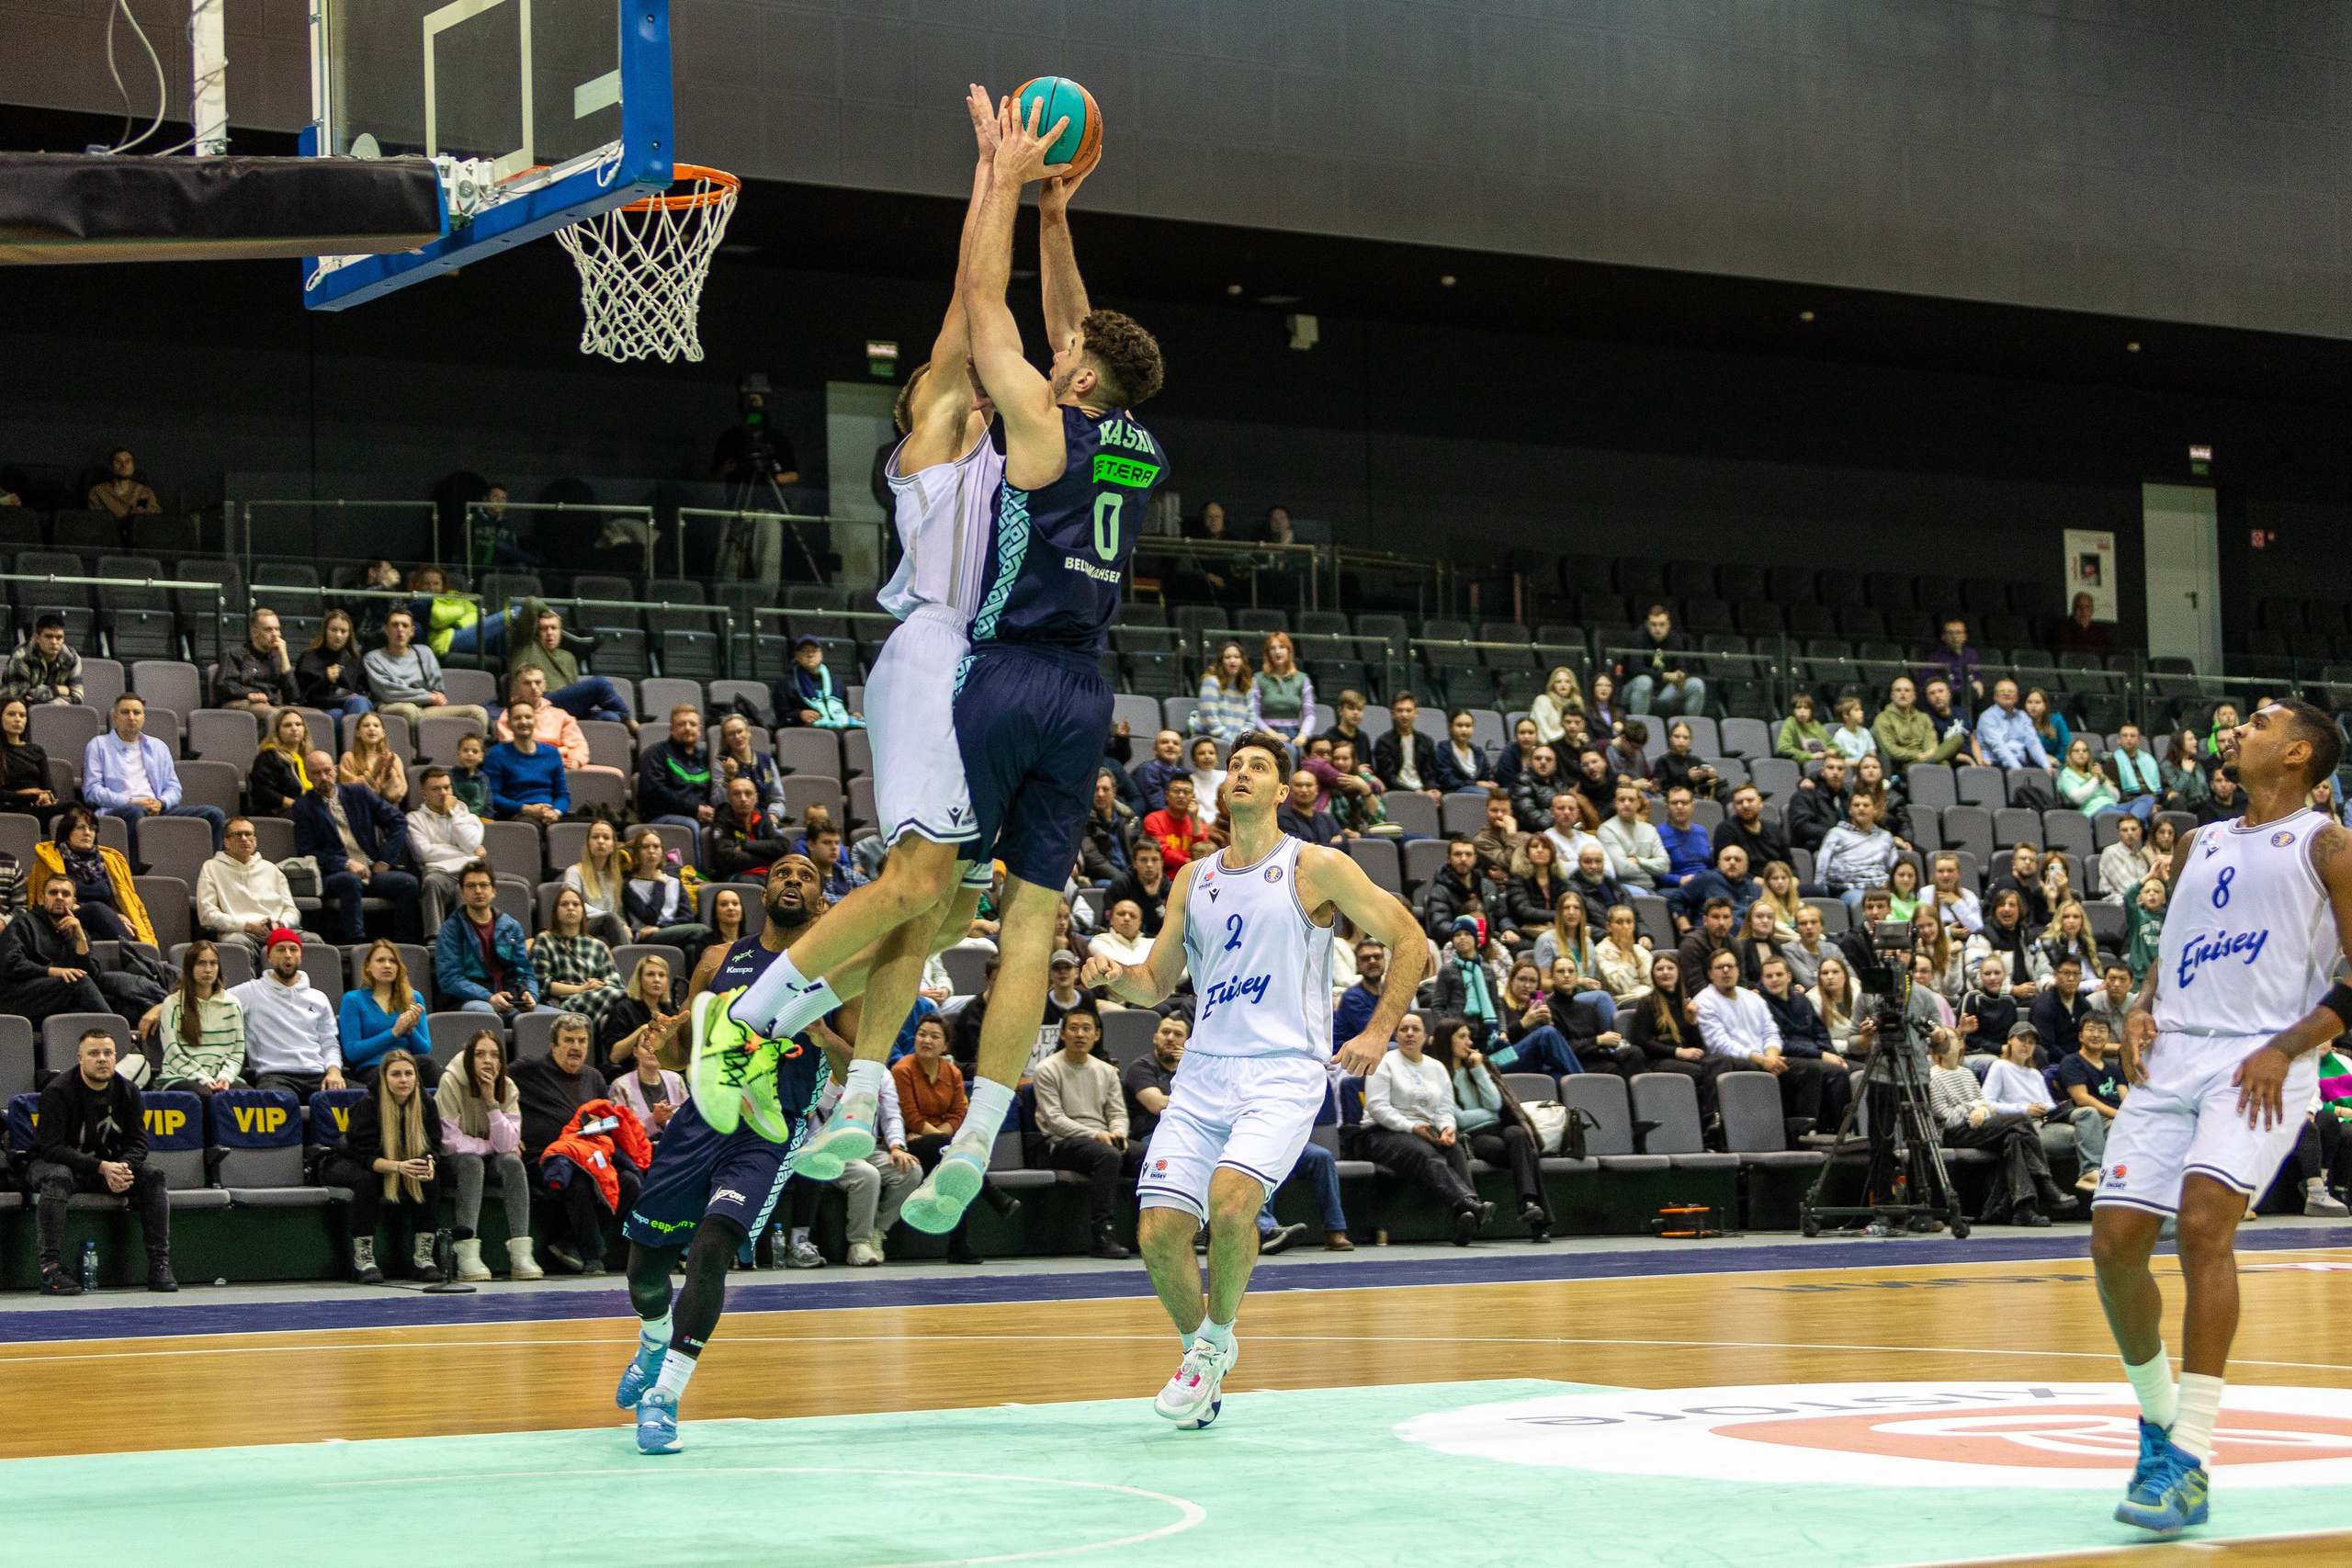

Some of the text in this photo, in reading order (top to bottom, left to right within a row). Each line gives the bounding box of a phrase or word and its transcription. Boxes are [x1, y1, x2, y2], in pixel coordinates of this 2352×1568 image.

[1093, 491, 1123, 561] 0
[2211, 866, 2235, 908] 8
[1224, 914, 1243, 952] 2
[726, 966, 753, 975] Kempa
[2177, 930, 2268, 988] Enisey
[233, 1107, 287, 1133] VIP
